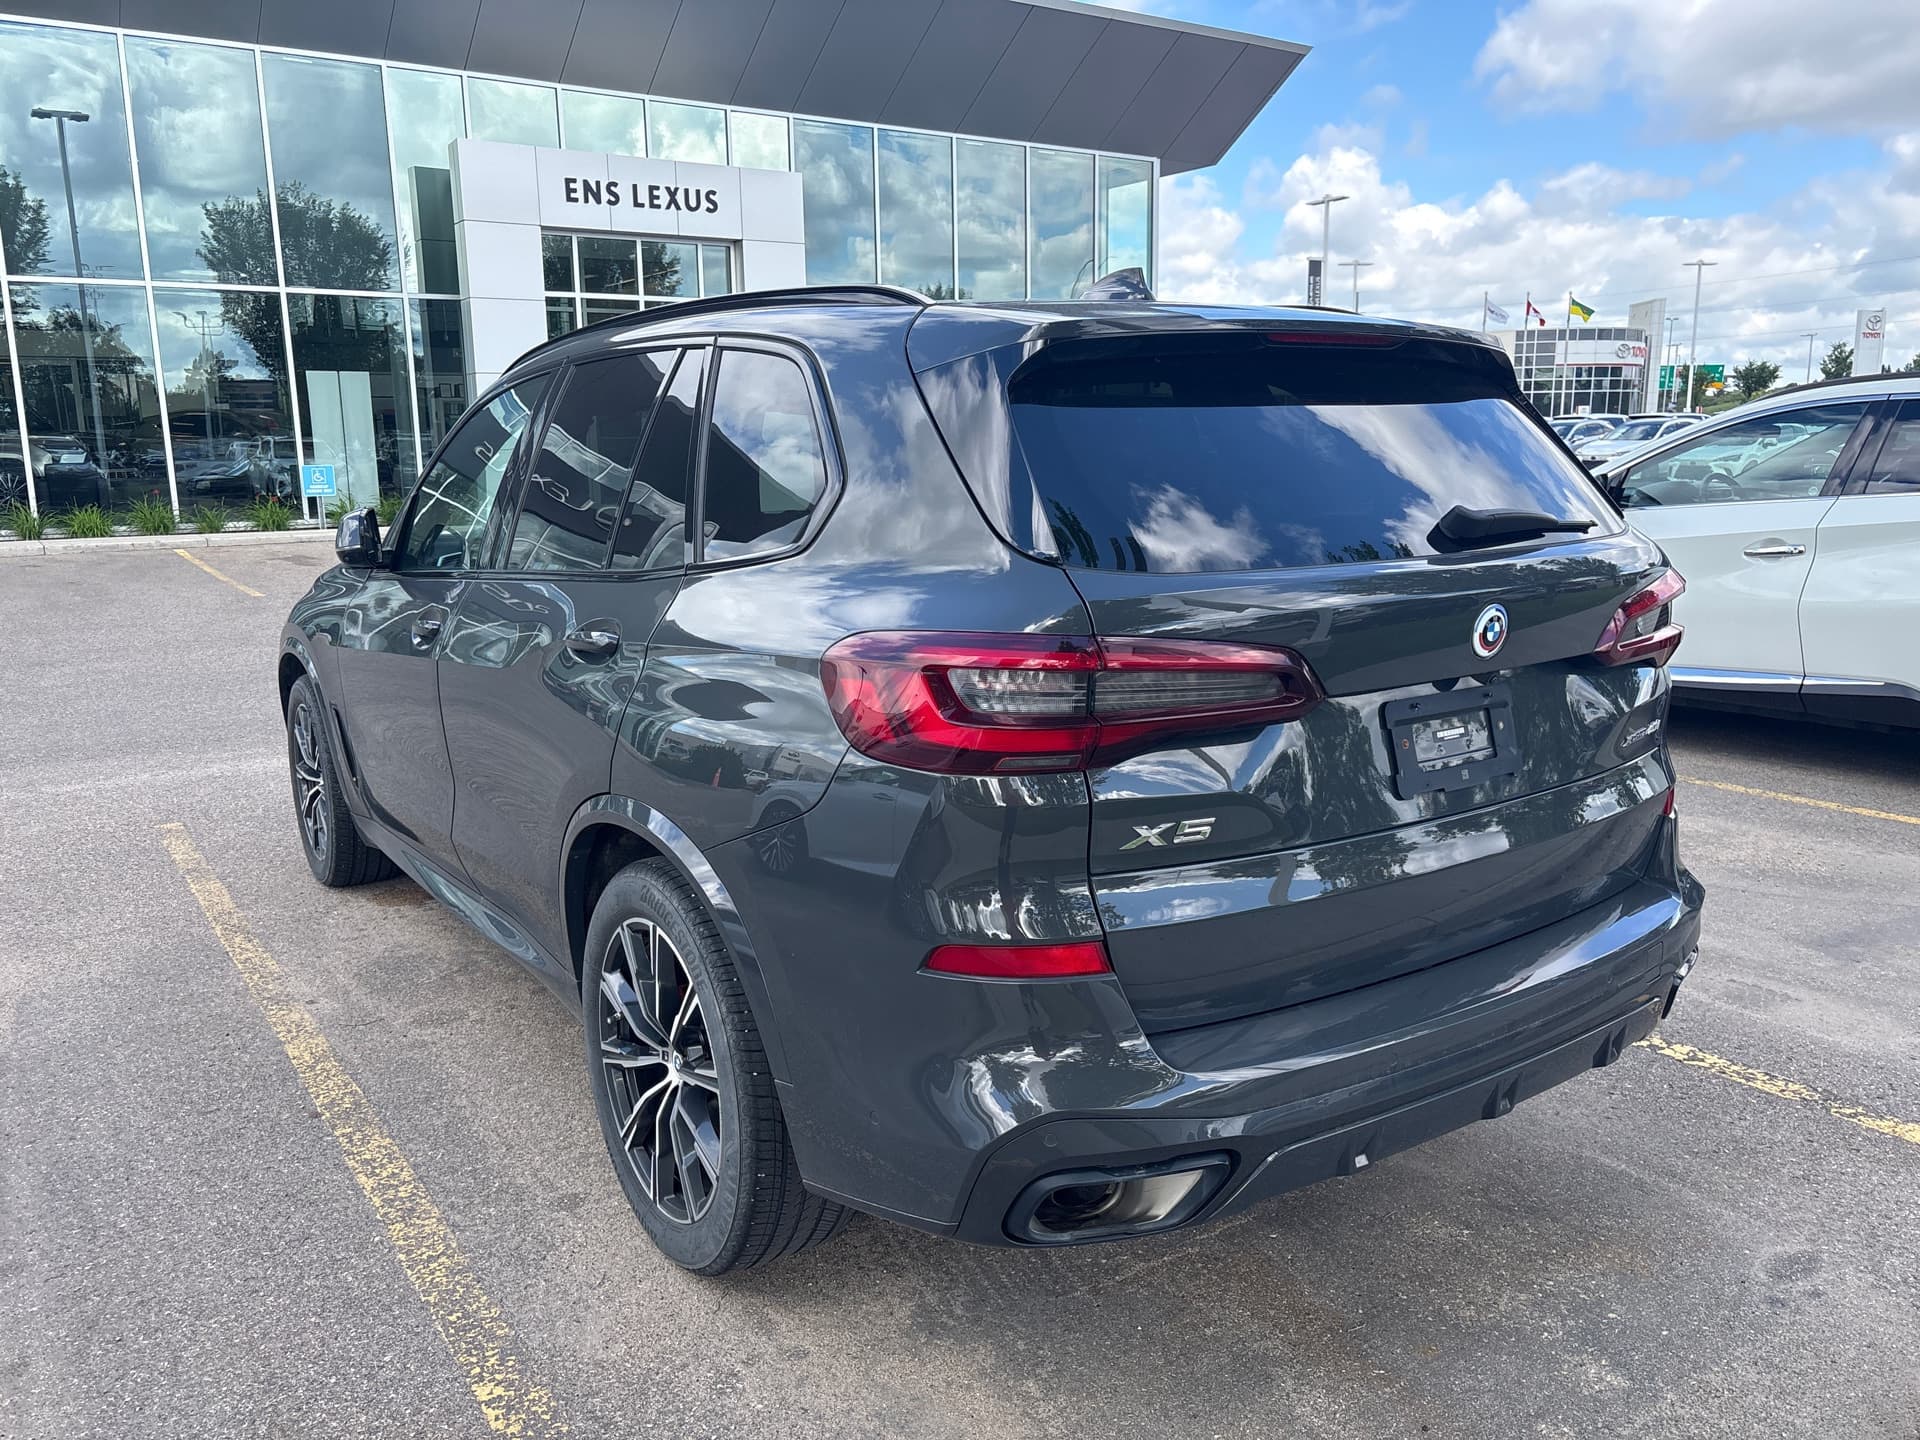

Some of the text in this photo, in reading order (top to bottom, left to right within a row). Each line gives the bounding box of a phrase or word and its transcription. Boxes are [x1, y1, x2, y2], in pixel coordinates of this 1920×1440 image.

[564, 177, 719, 214] ENS LEXUS
[1119, 817, 1216, 850] X5
[640, 884, 709, 995] BRIDGESTONE
